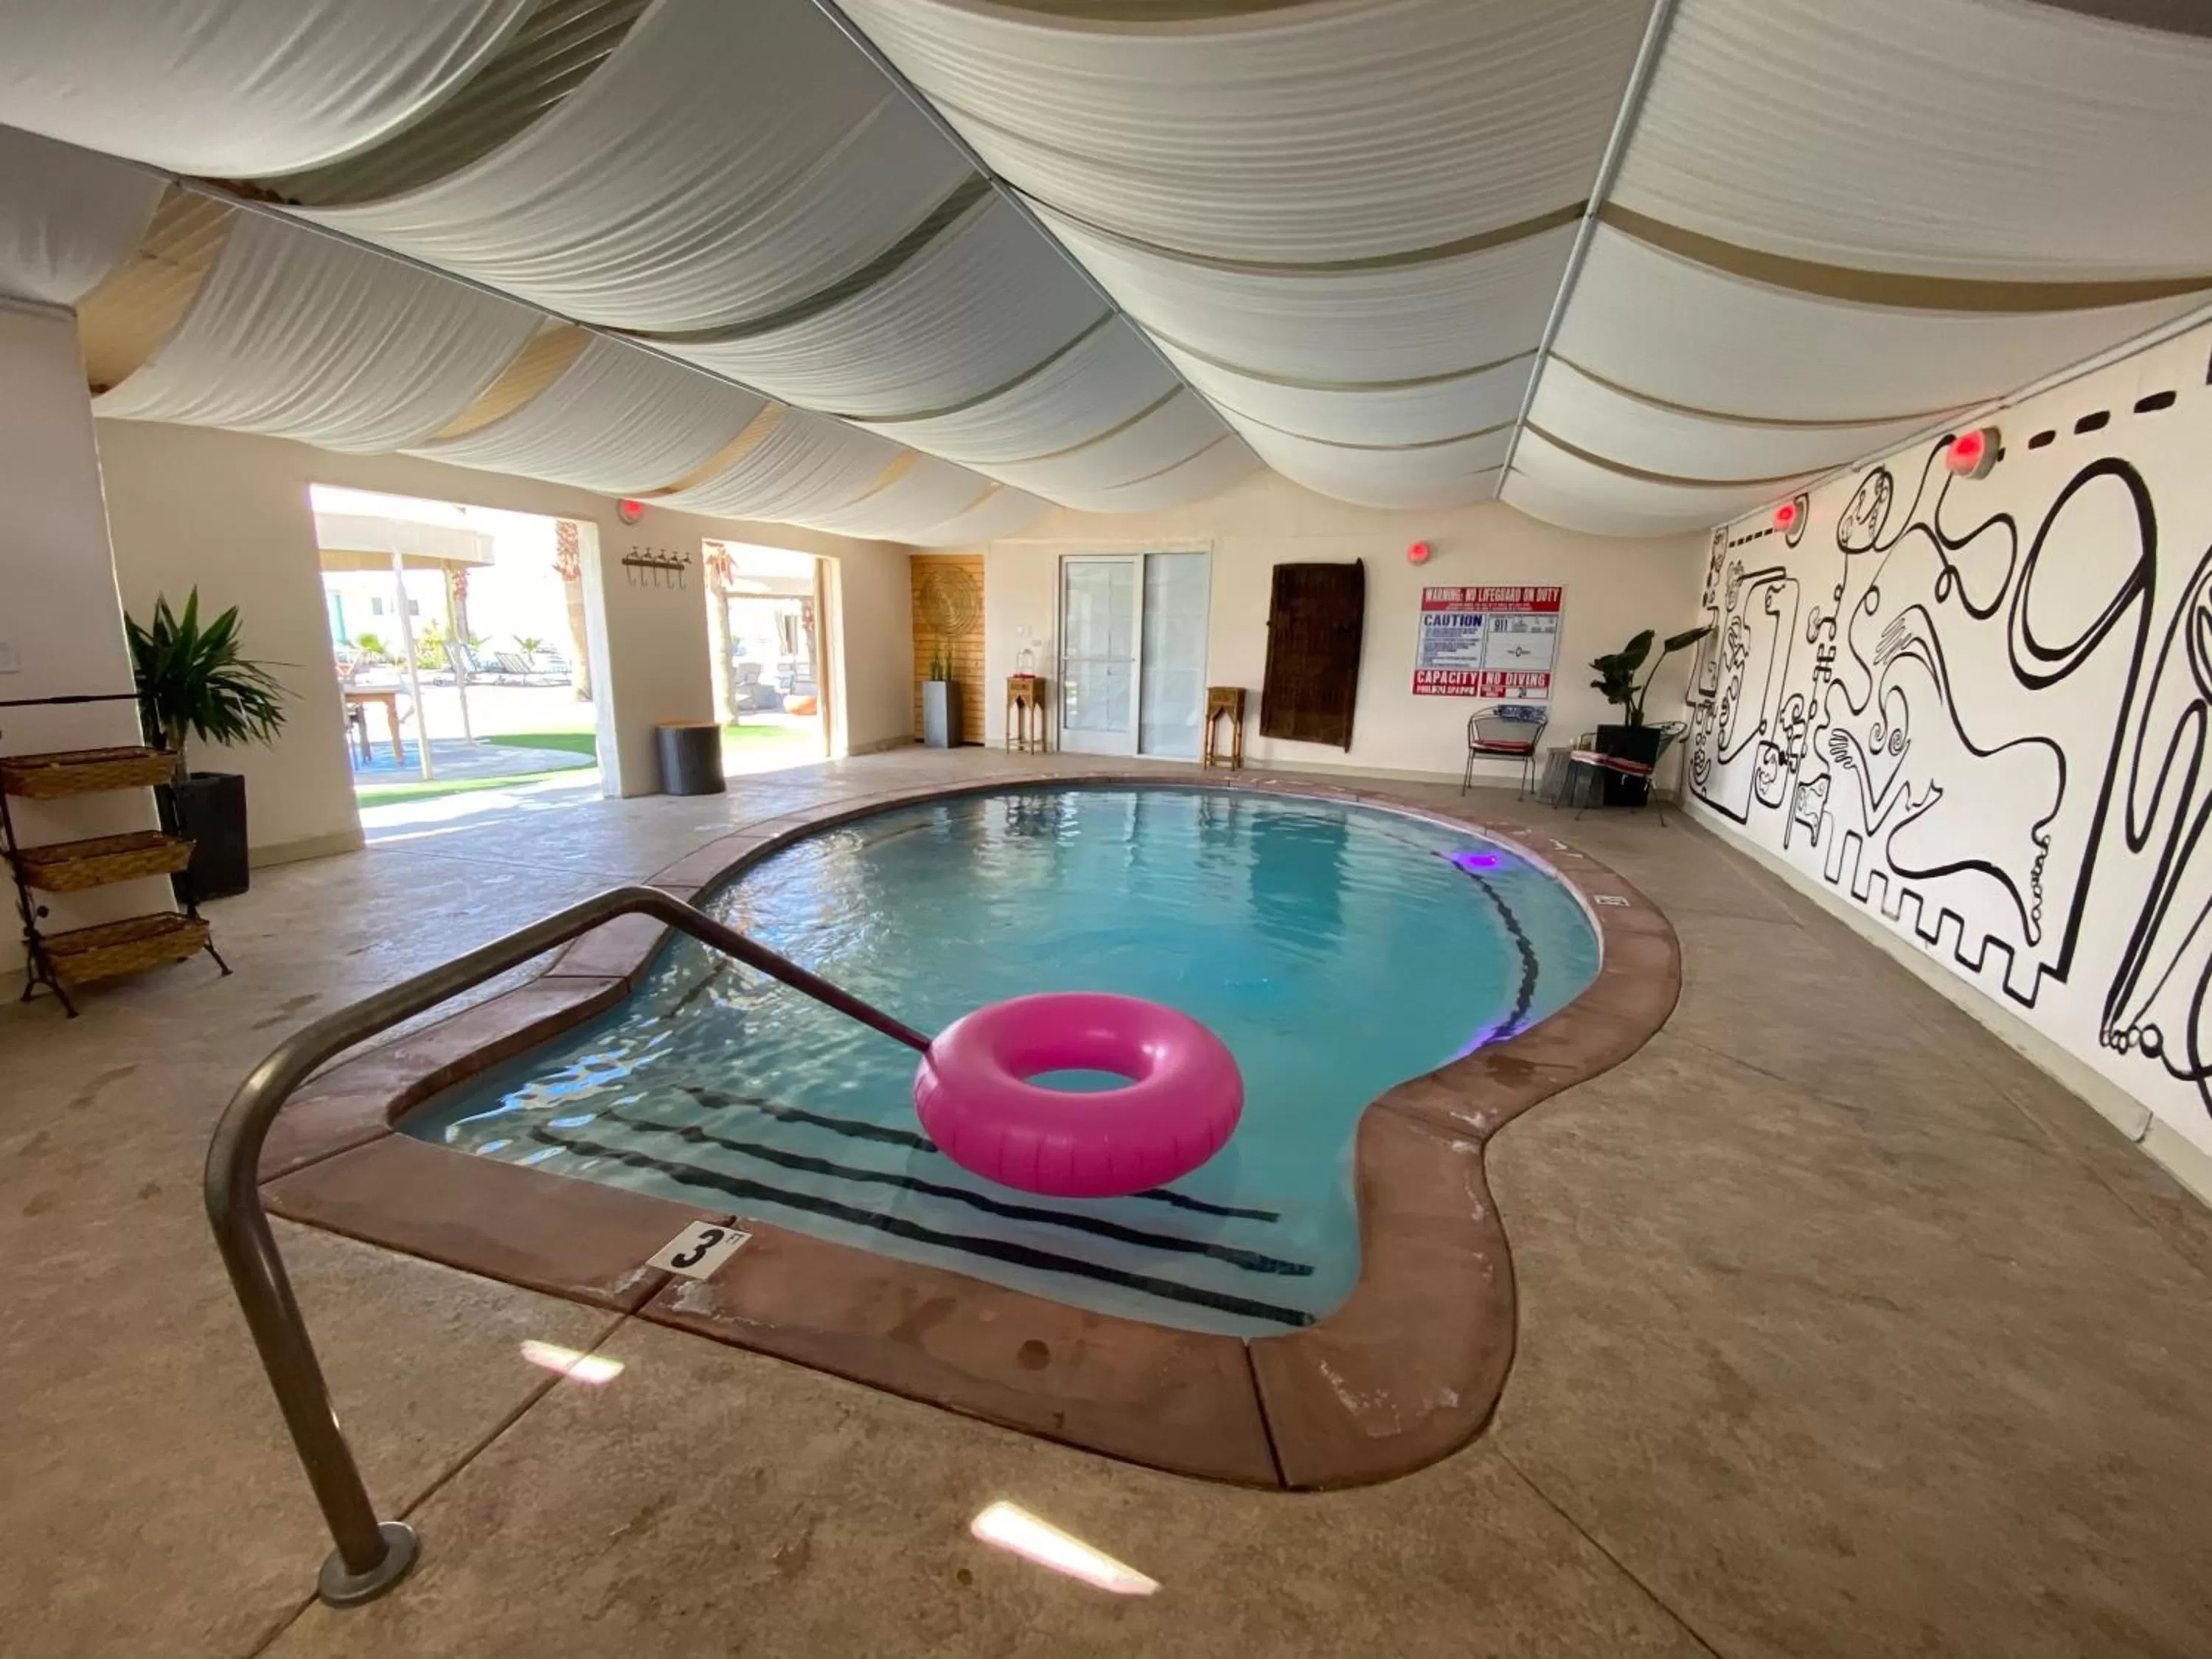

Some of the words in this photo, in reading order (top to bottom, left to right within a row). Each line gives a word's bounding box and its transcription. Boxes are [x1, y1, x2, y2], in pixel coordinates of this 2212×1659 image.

[1465, 588, 1477, 602] NO
[1523, 588, 1534, 602] ON
[1536, 588, 1559, 602] DUTY
[1424, 614, 1483, 627] CAUTION
[1495, 619, 1508, 632] 911
[1417, 670, 1477, 684] CAPACITY
[1486, 672, 1501, 685] NO
[1506, 672, 1546, 686] DIVING
[671, 1229, 725, 1268] 3
